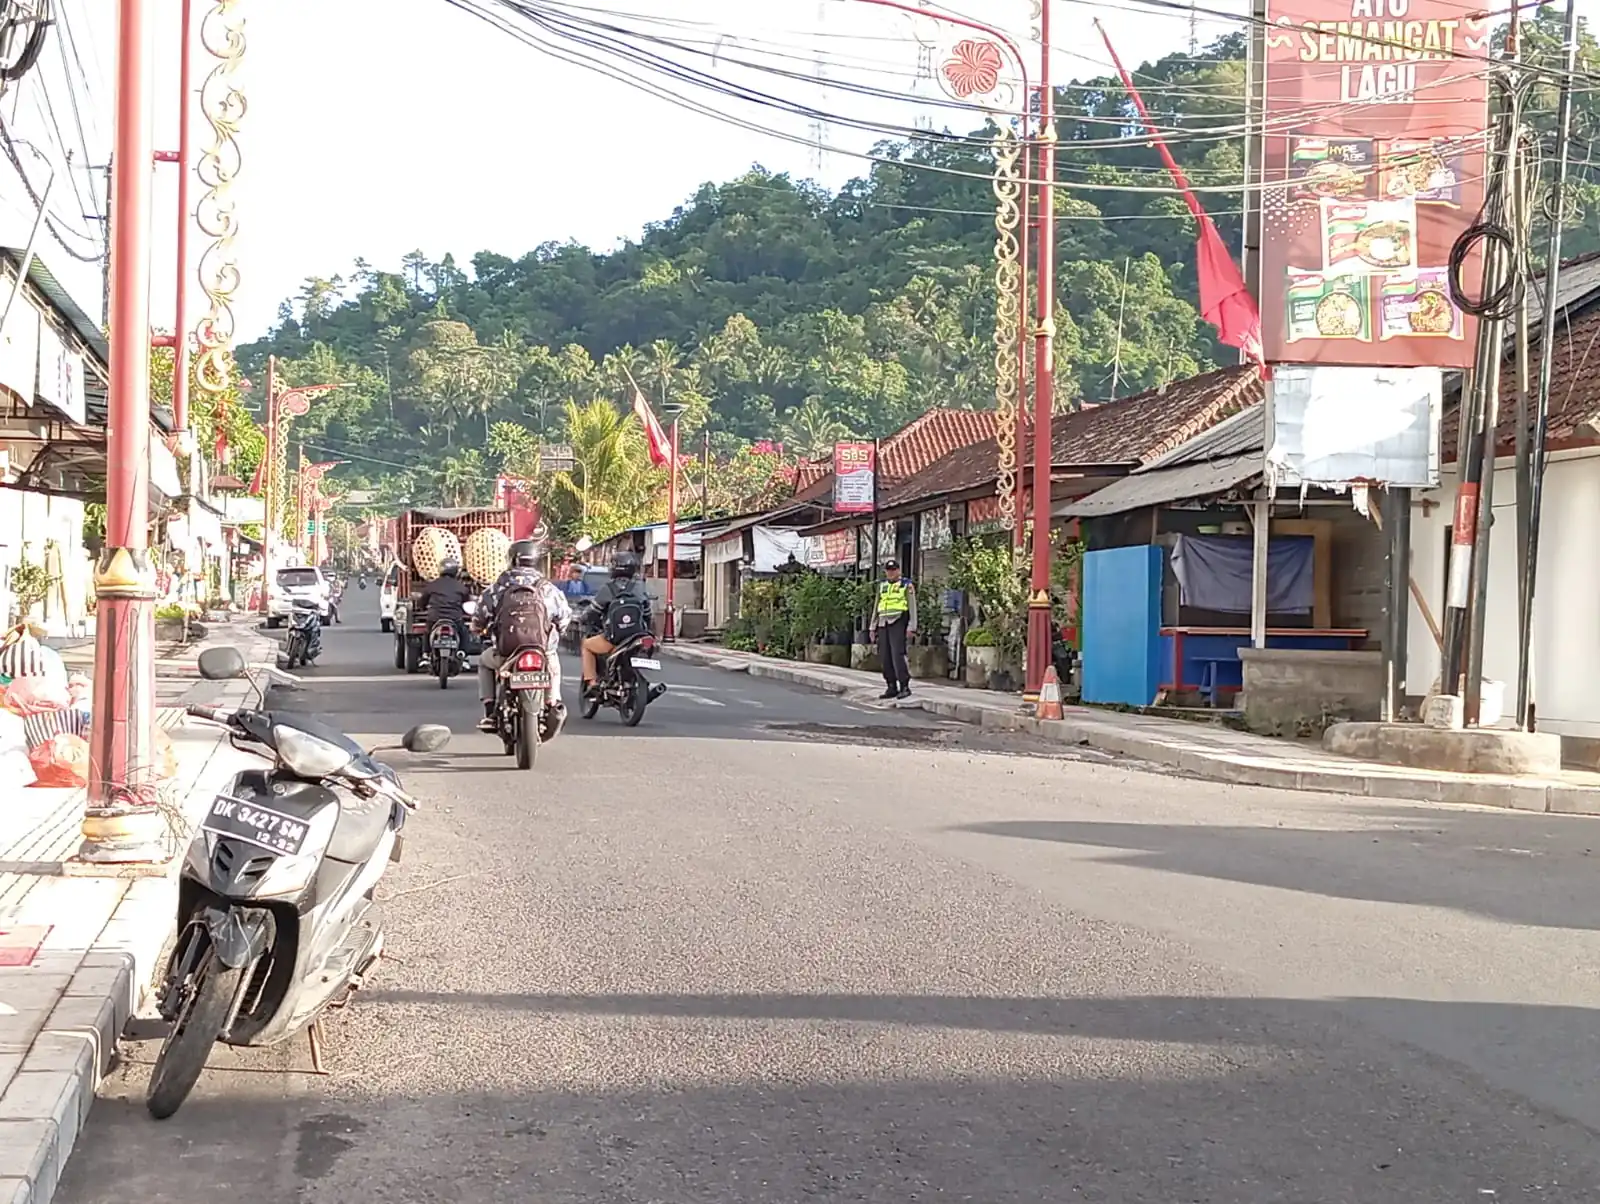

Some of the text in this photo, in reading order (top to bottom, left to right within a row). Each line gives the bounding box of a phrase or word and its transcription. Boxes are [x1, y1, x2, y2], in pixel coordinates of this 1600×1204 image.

[1299, 21, 1460, 62] SEMANGAT
[213, 799, 304, 841] DK 3427 SM
